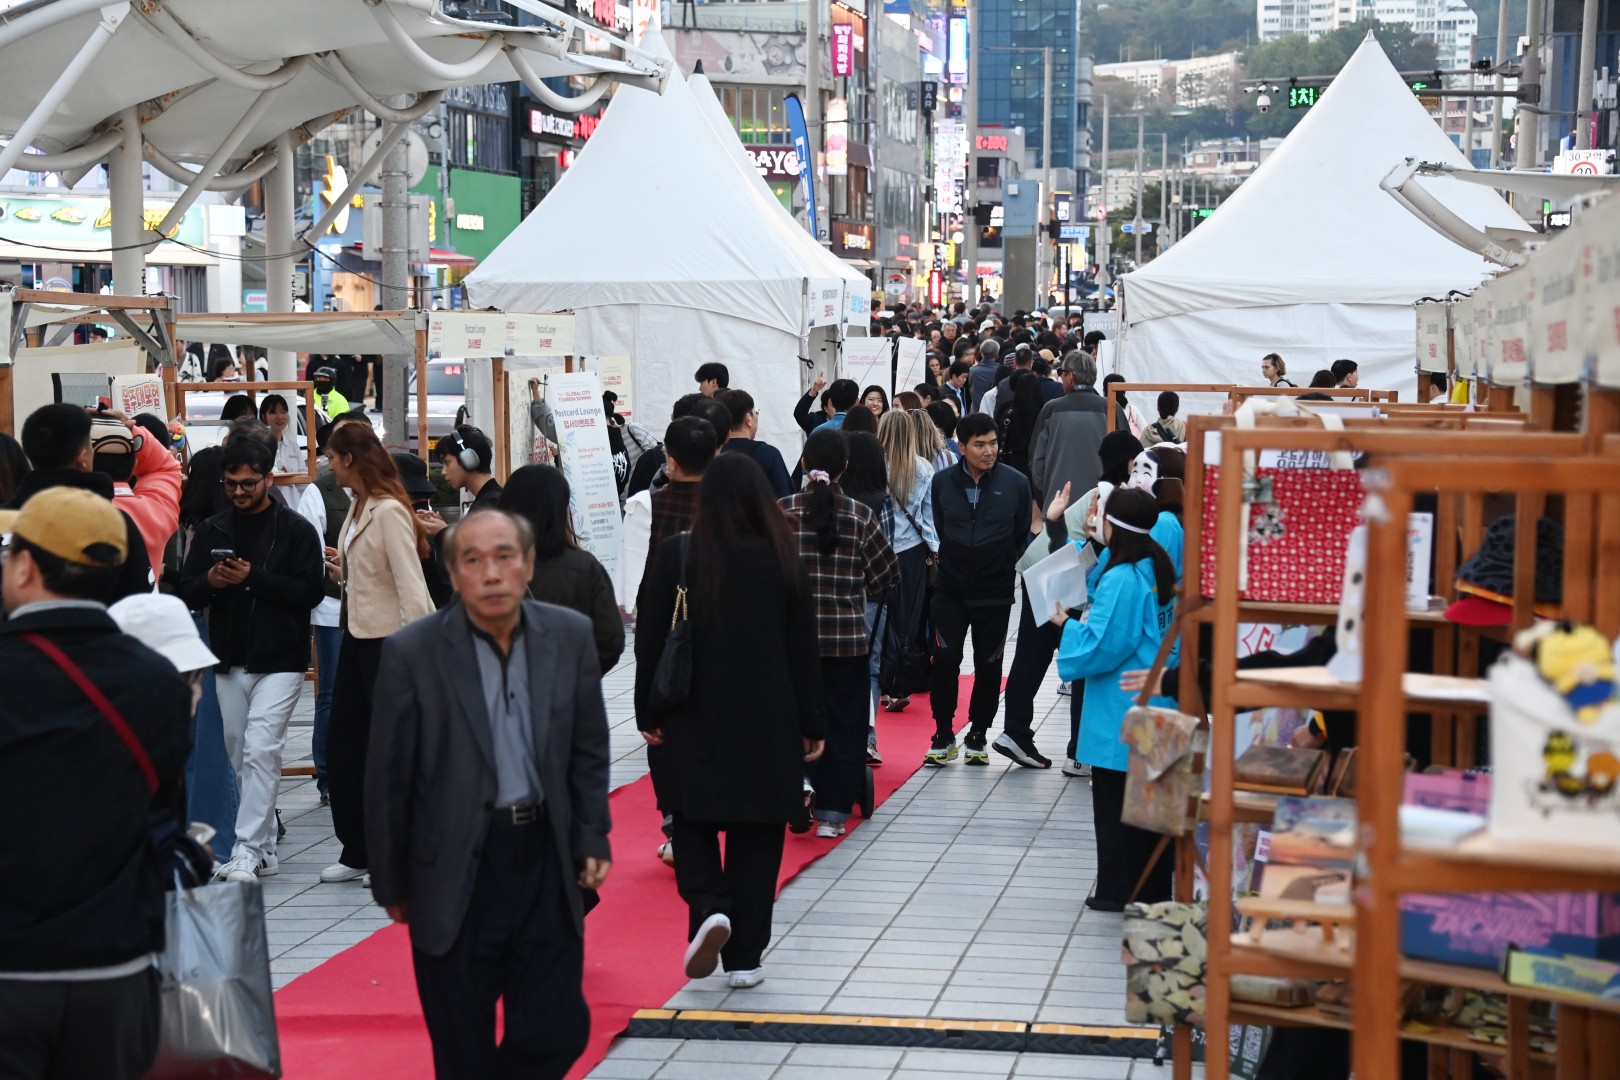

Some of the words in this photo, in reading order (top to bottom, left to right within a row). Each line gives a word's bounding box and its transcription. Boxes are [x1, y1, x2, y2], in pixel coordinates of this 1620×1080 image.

[925, 83, 933, 108] BAR
[1569, 152, 1580, 161] 30
[1584, 152, 1602, 160] 구역
[122, 382, 160, 414] 울주대모험
[554, 408, 579, 417] Postcard
[580, 407, 602, 416] Lounge
